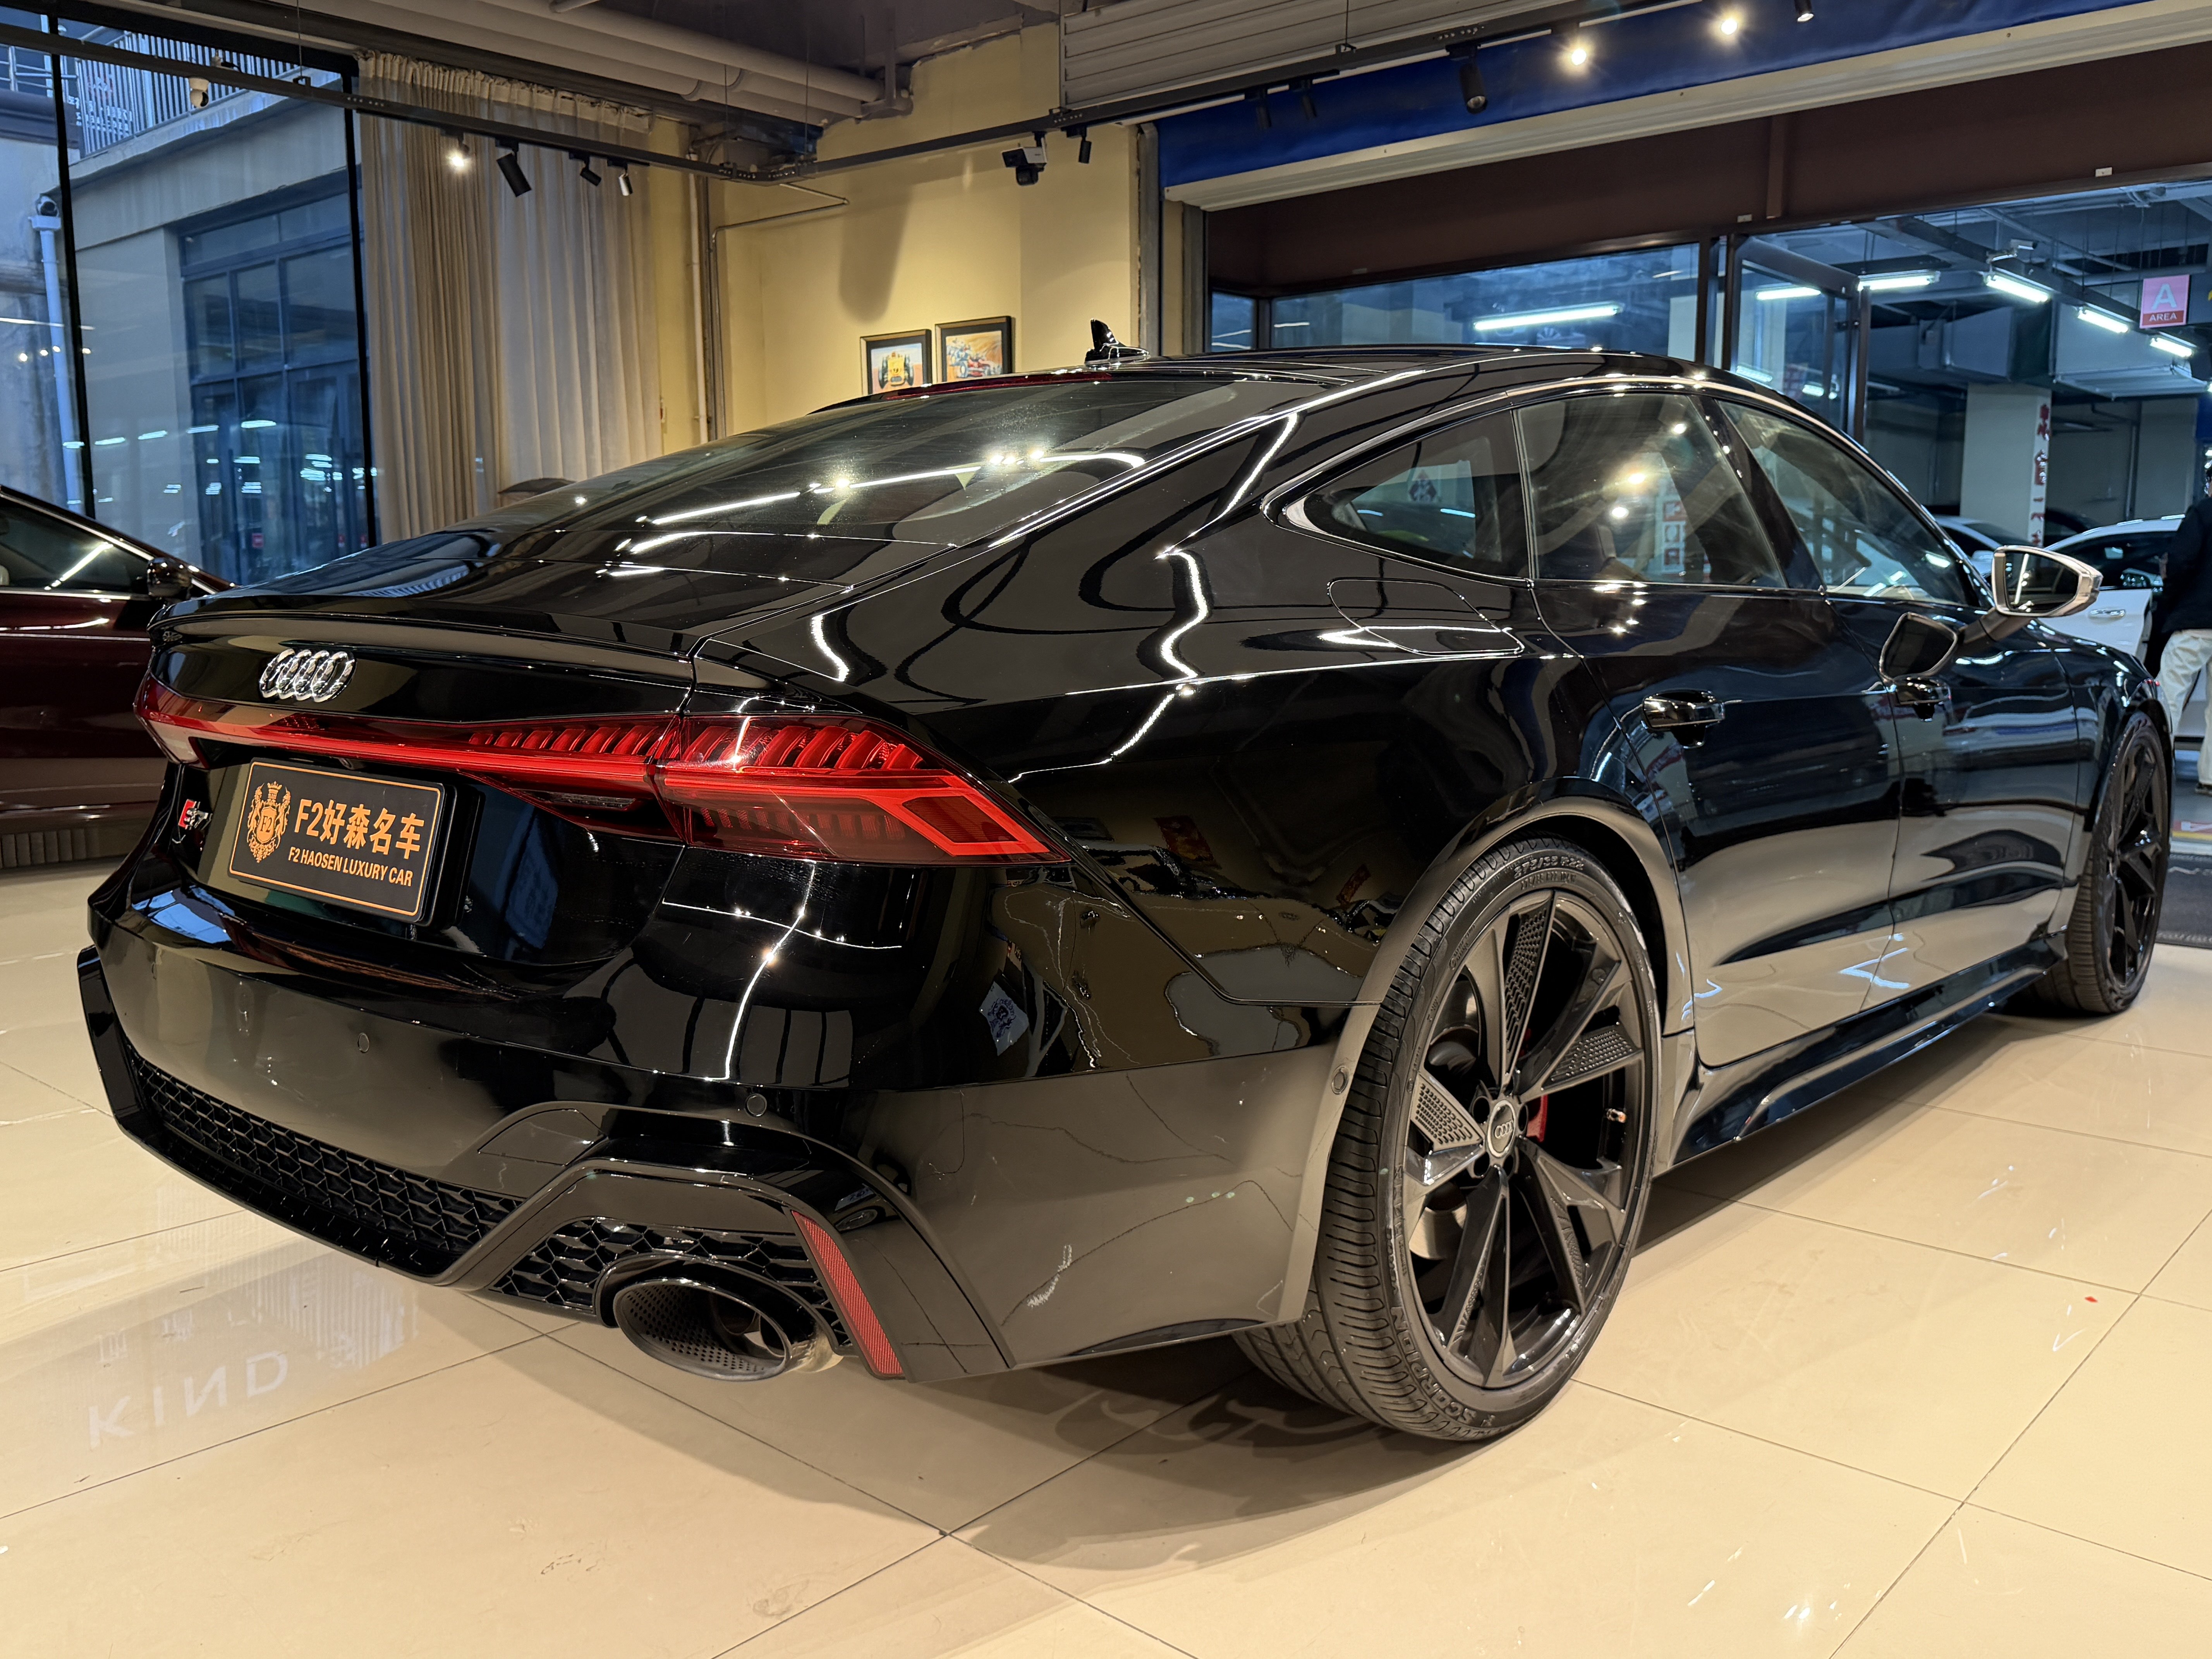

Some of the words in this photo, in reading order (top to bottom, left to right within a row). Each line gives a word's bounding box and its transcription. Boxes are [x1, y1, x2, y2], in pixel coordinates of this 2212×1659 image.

[2152, 283, 2177, 310] A
[2149, 312, 2177, 322] AREA
[294, 799, 424, 859] F2好森名车
[288, 847, 299, 863] F2
[300, 849, 342, 872] HAOSEN
[342, 857, 388, 881] LUXURY
[388, 867, 413, 887] CAR
[1390, 1307, 1477, 1425] SCORPION
